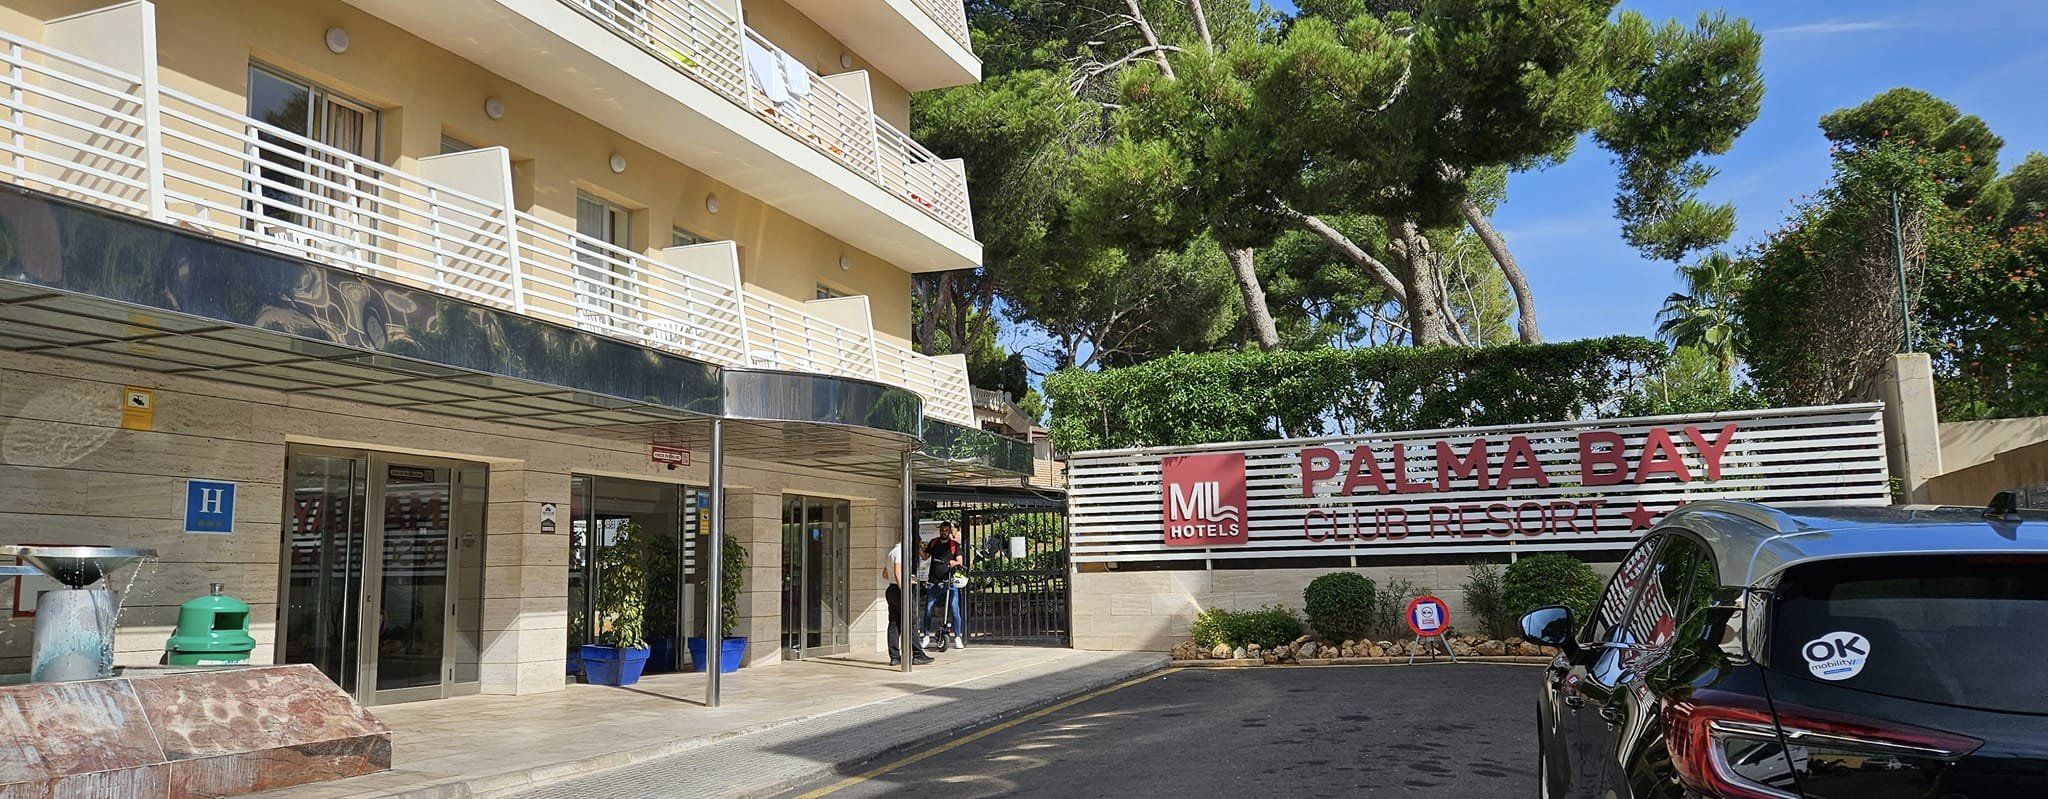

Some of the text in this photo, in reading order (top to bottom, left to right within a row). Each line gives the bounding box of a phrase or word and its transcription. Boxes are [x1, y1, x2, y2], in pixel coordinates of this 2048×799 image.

[1301, 424, 1738, 497] PALMA BAY
[200, 487, 224, 514] H
[1171, 523, 1239, 538] HOTELS
[1304, 500, 1608, 542] CLUB RESORT
[1806, 636, 1866, 661] OK
[1811, 659, 1853, 671] mobility
